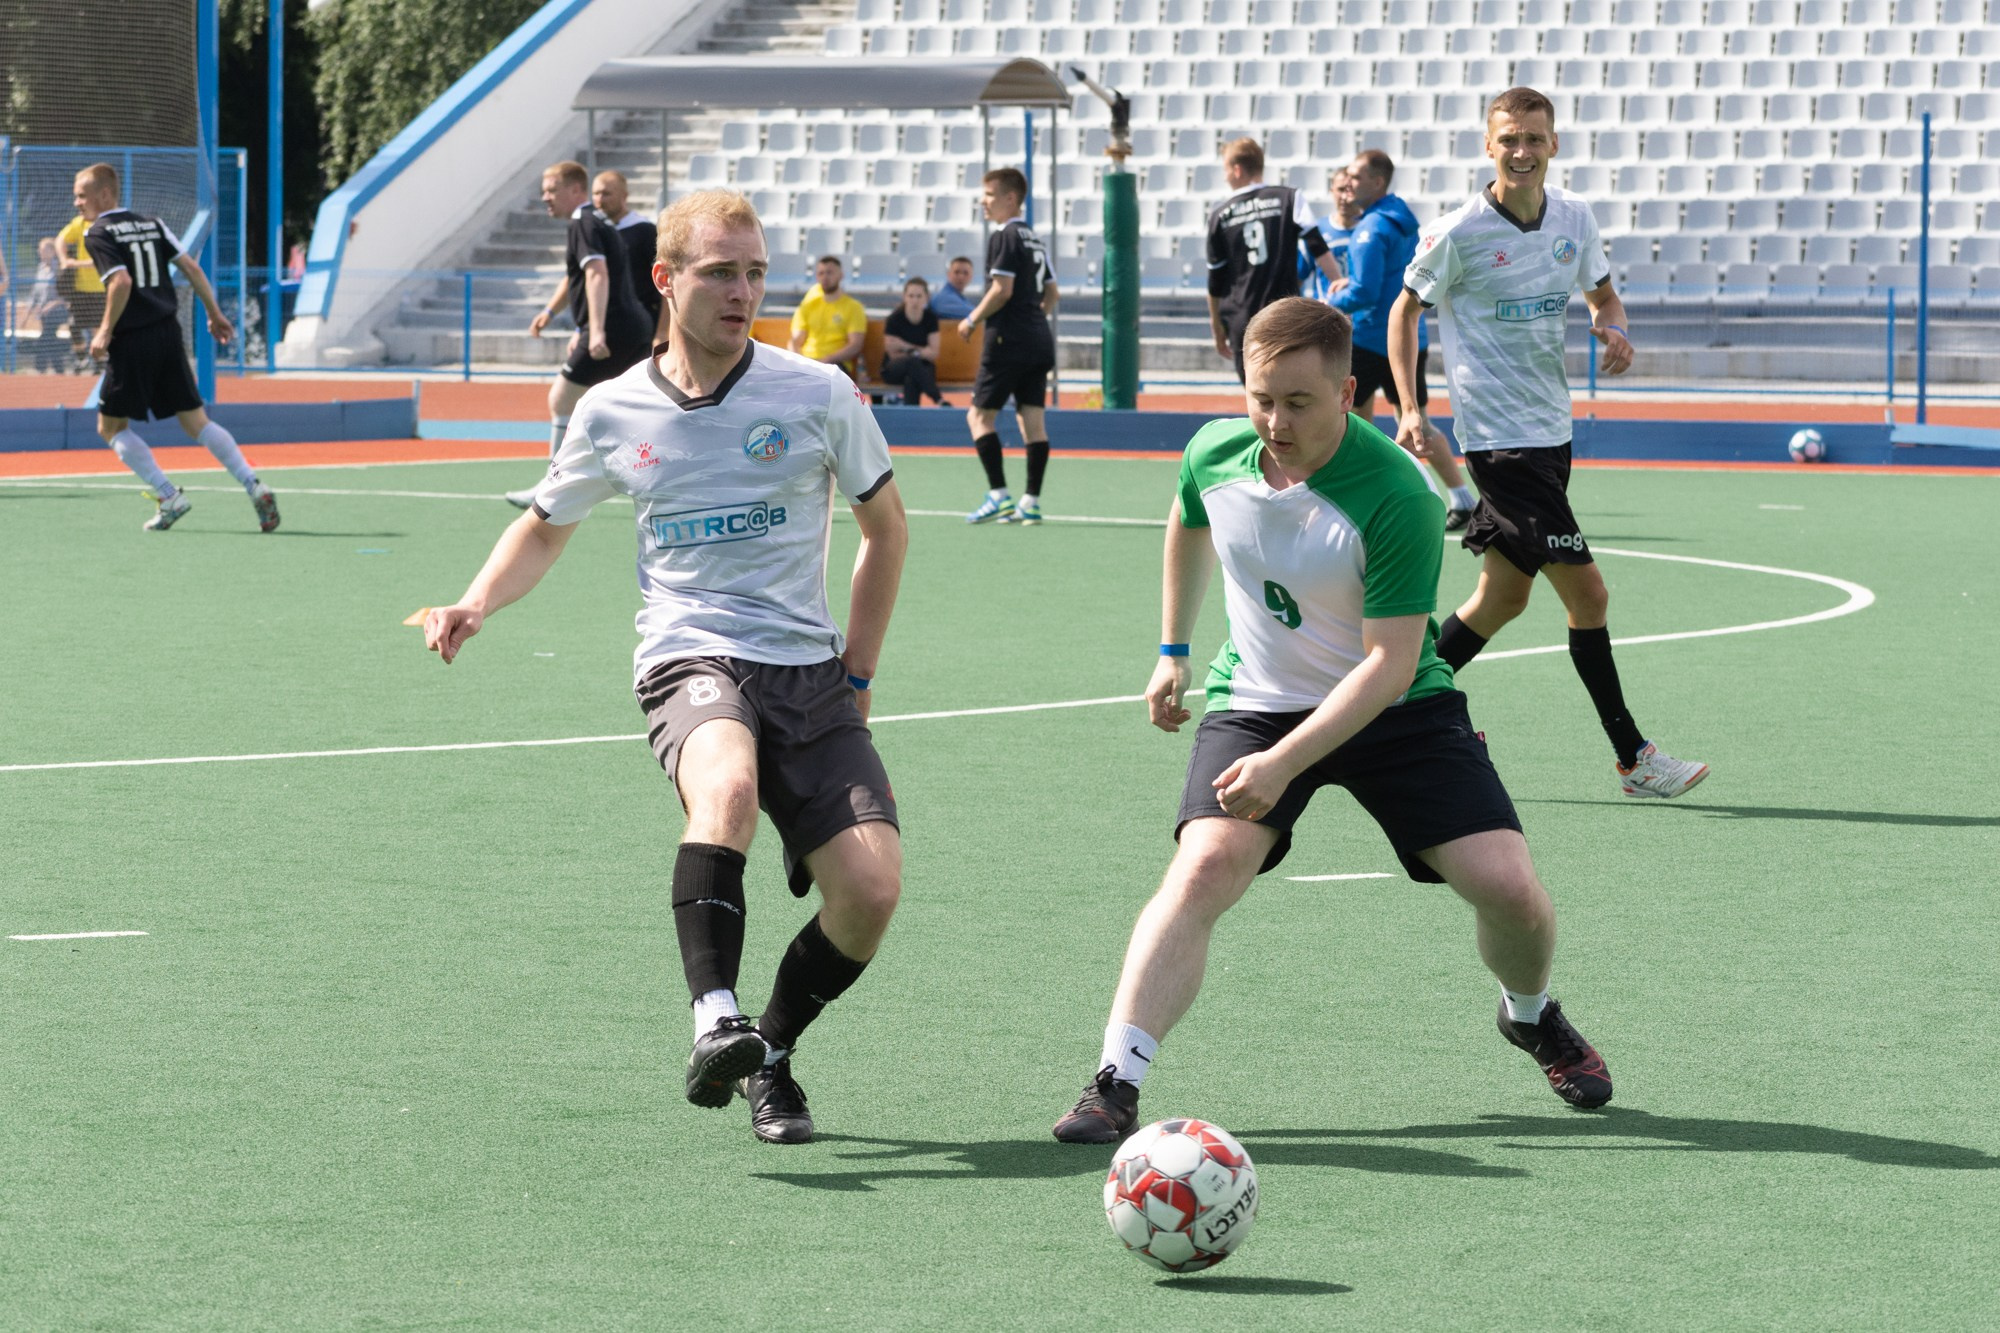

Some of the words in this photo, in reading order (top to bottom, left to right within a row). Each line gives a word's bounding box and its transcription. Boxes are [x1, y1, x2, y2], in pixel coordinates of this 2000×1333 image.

[129, 241, 160, 288] 11
[1243, 220, 1268, 266] 9
[1033, 251, 1046, 293] 7
[633, 457, 661, 470] KELME
[1547, 532, 1584, 552] nag
[1263, 579, 1303, 630] 9
[688, 676, 722, 706] 8
[1205, 1178, 1256, 1244] SELECT
